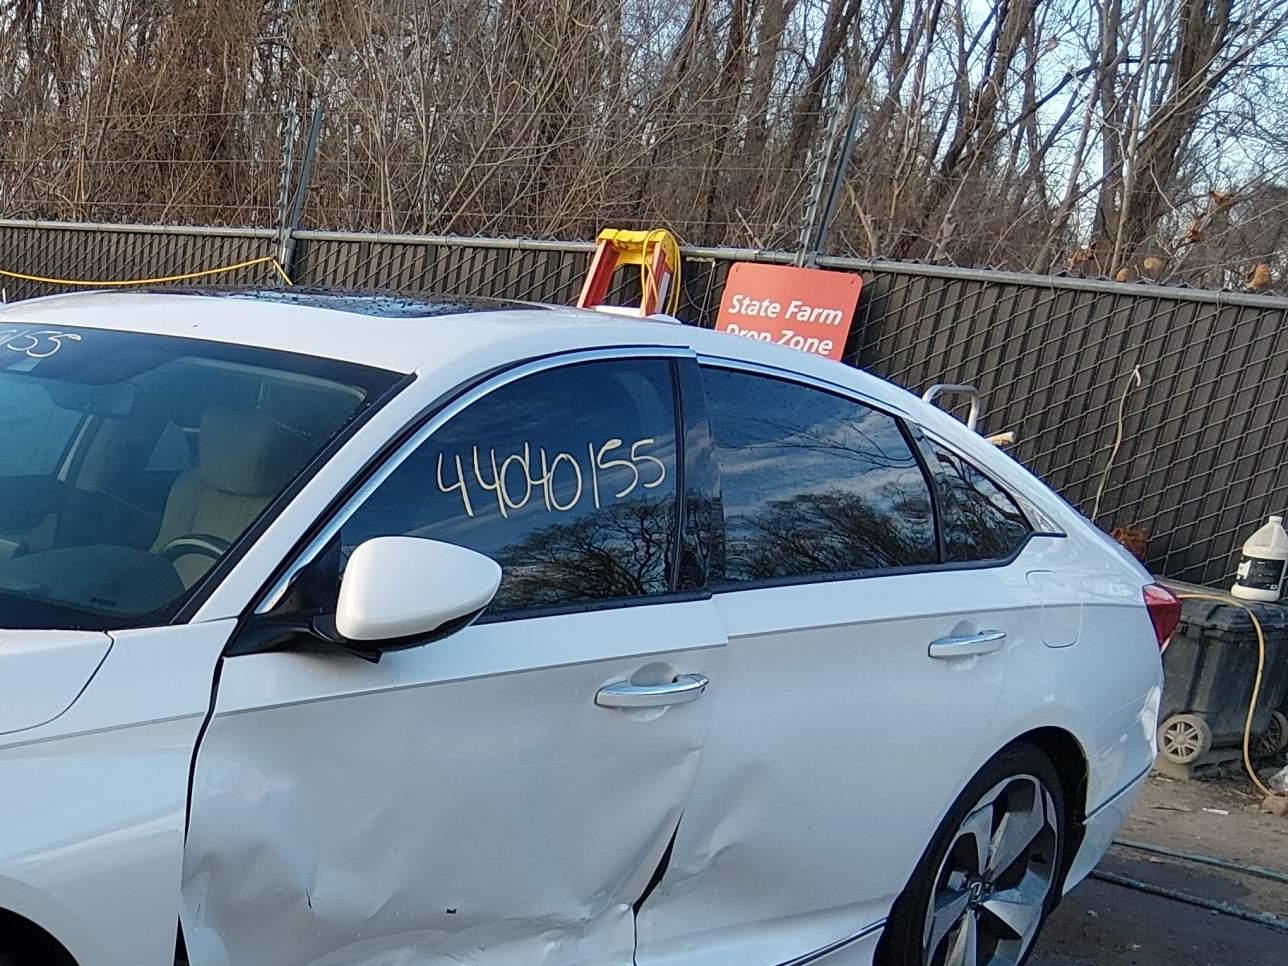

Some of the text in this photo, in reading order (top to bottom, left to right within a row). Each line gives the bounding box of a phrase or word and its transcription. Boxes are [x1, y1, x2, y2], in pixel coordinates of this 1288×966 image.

[727, 294, 843, 326] State Farm
[776, 329, 834, 355] Zone
[436, 438, 666, 519] 44040155
